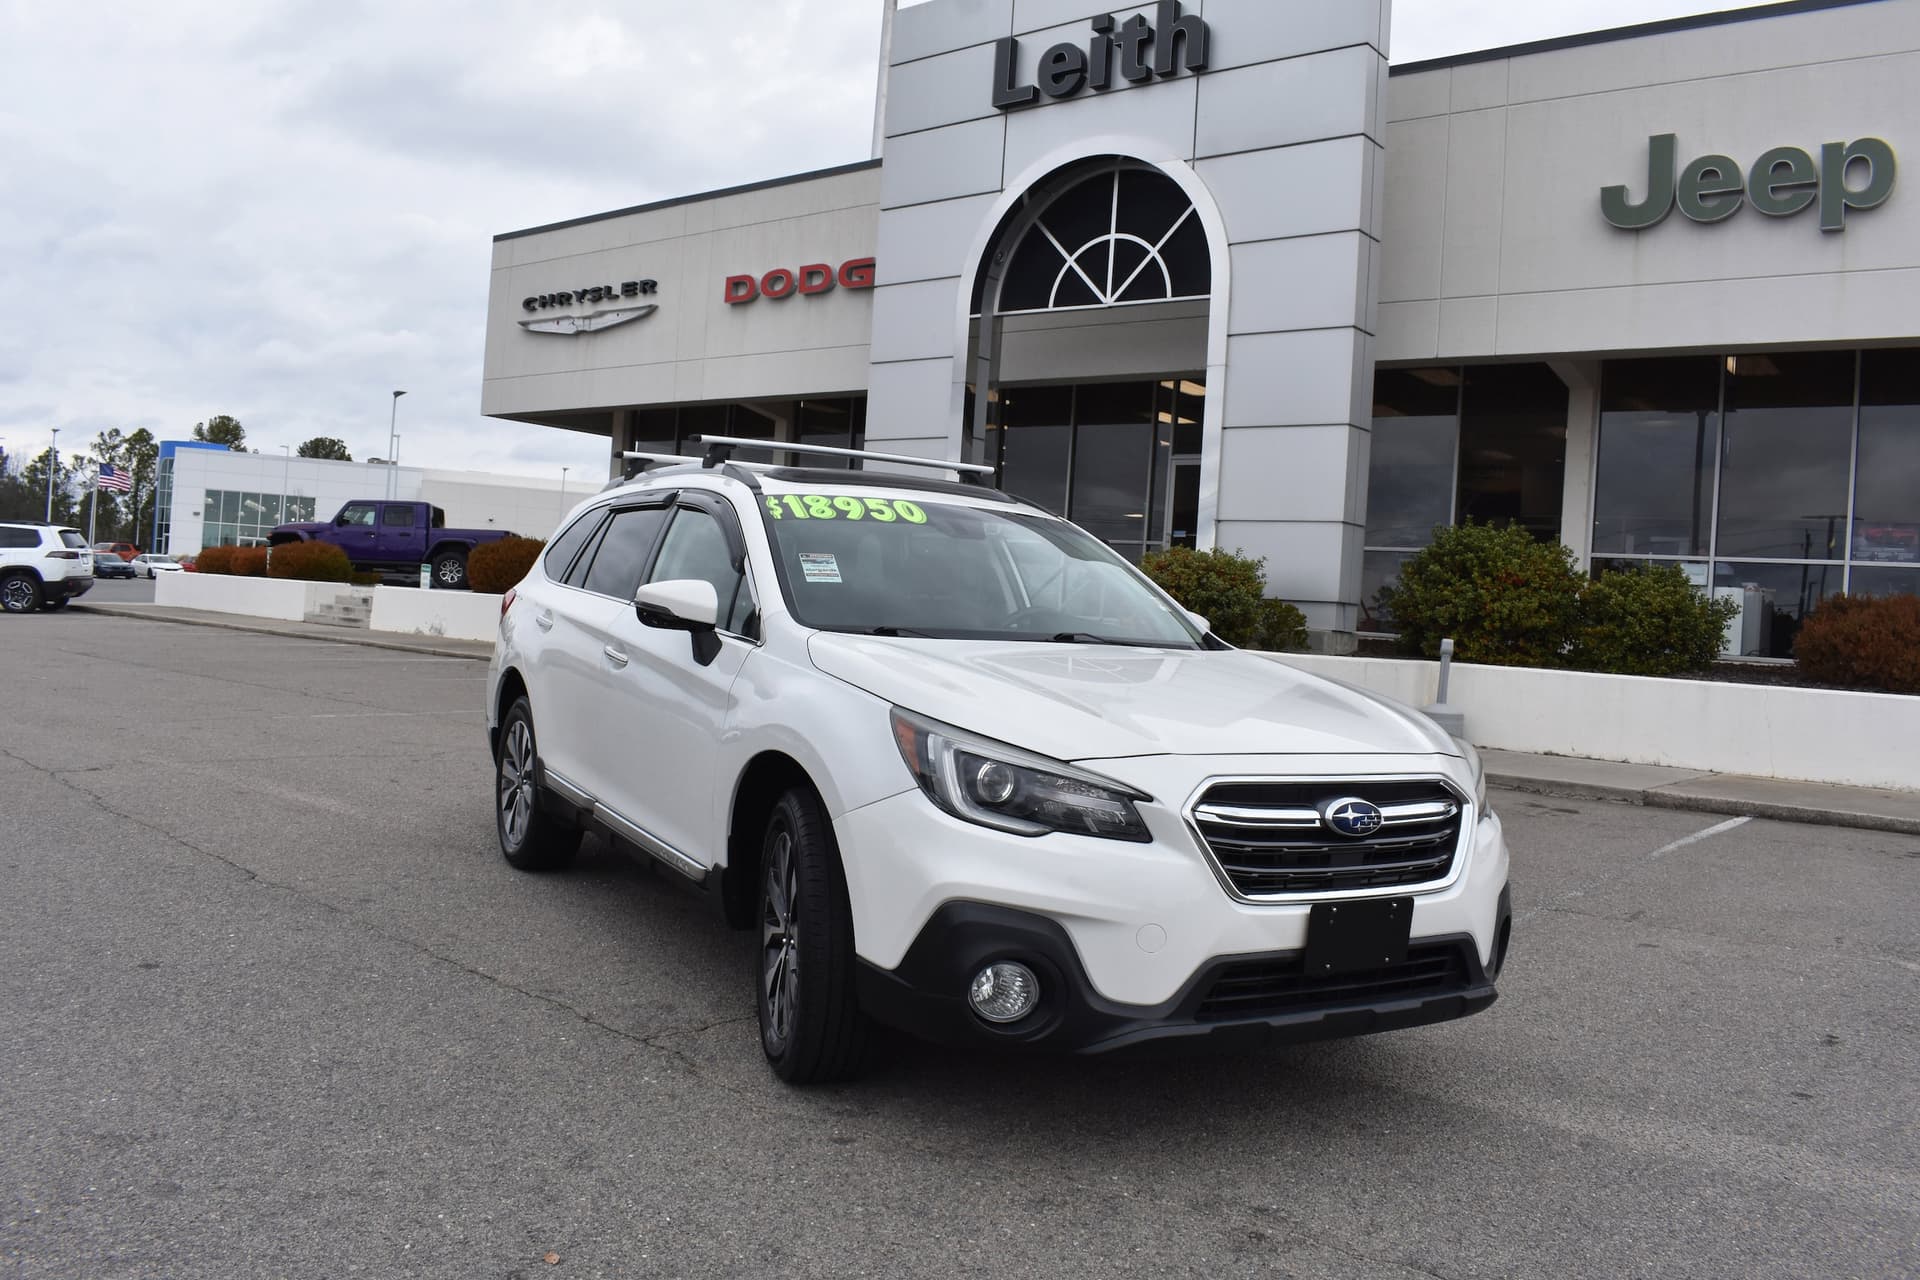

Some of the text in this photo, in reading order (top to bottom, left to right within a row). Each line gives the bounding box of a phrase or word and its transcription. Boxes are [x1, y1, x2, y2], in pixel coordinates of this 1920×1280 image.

[992, 0, 1210, 109] Leith
[1600, 133, 1897, 232] Jeep
[522, 279, 658, 312] CHRYSLER
[724, 256, 876, 304] DODG
[766, 494, 928, 525] $18950
